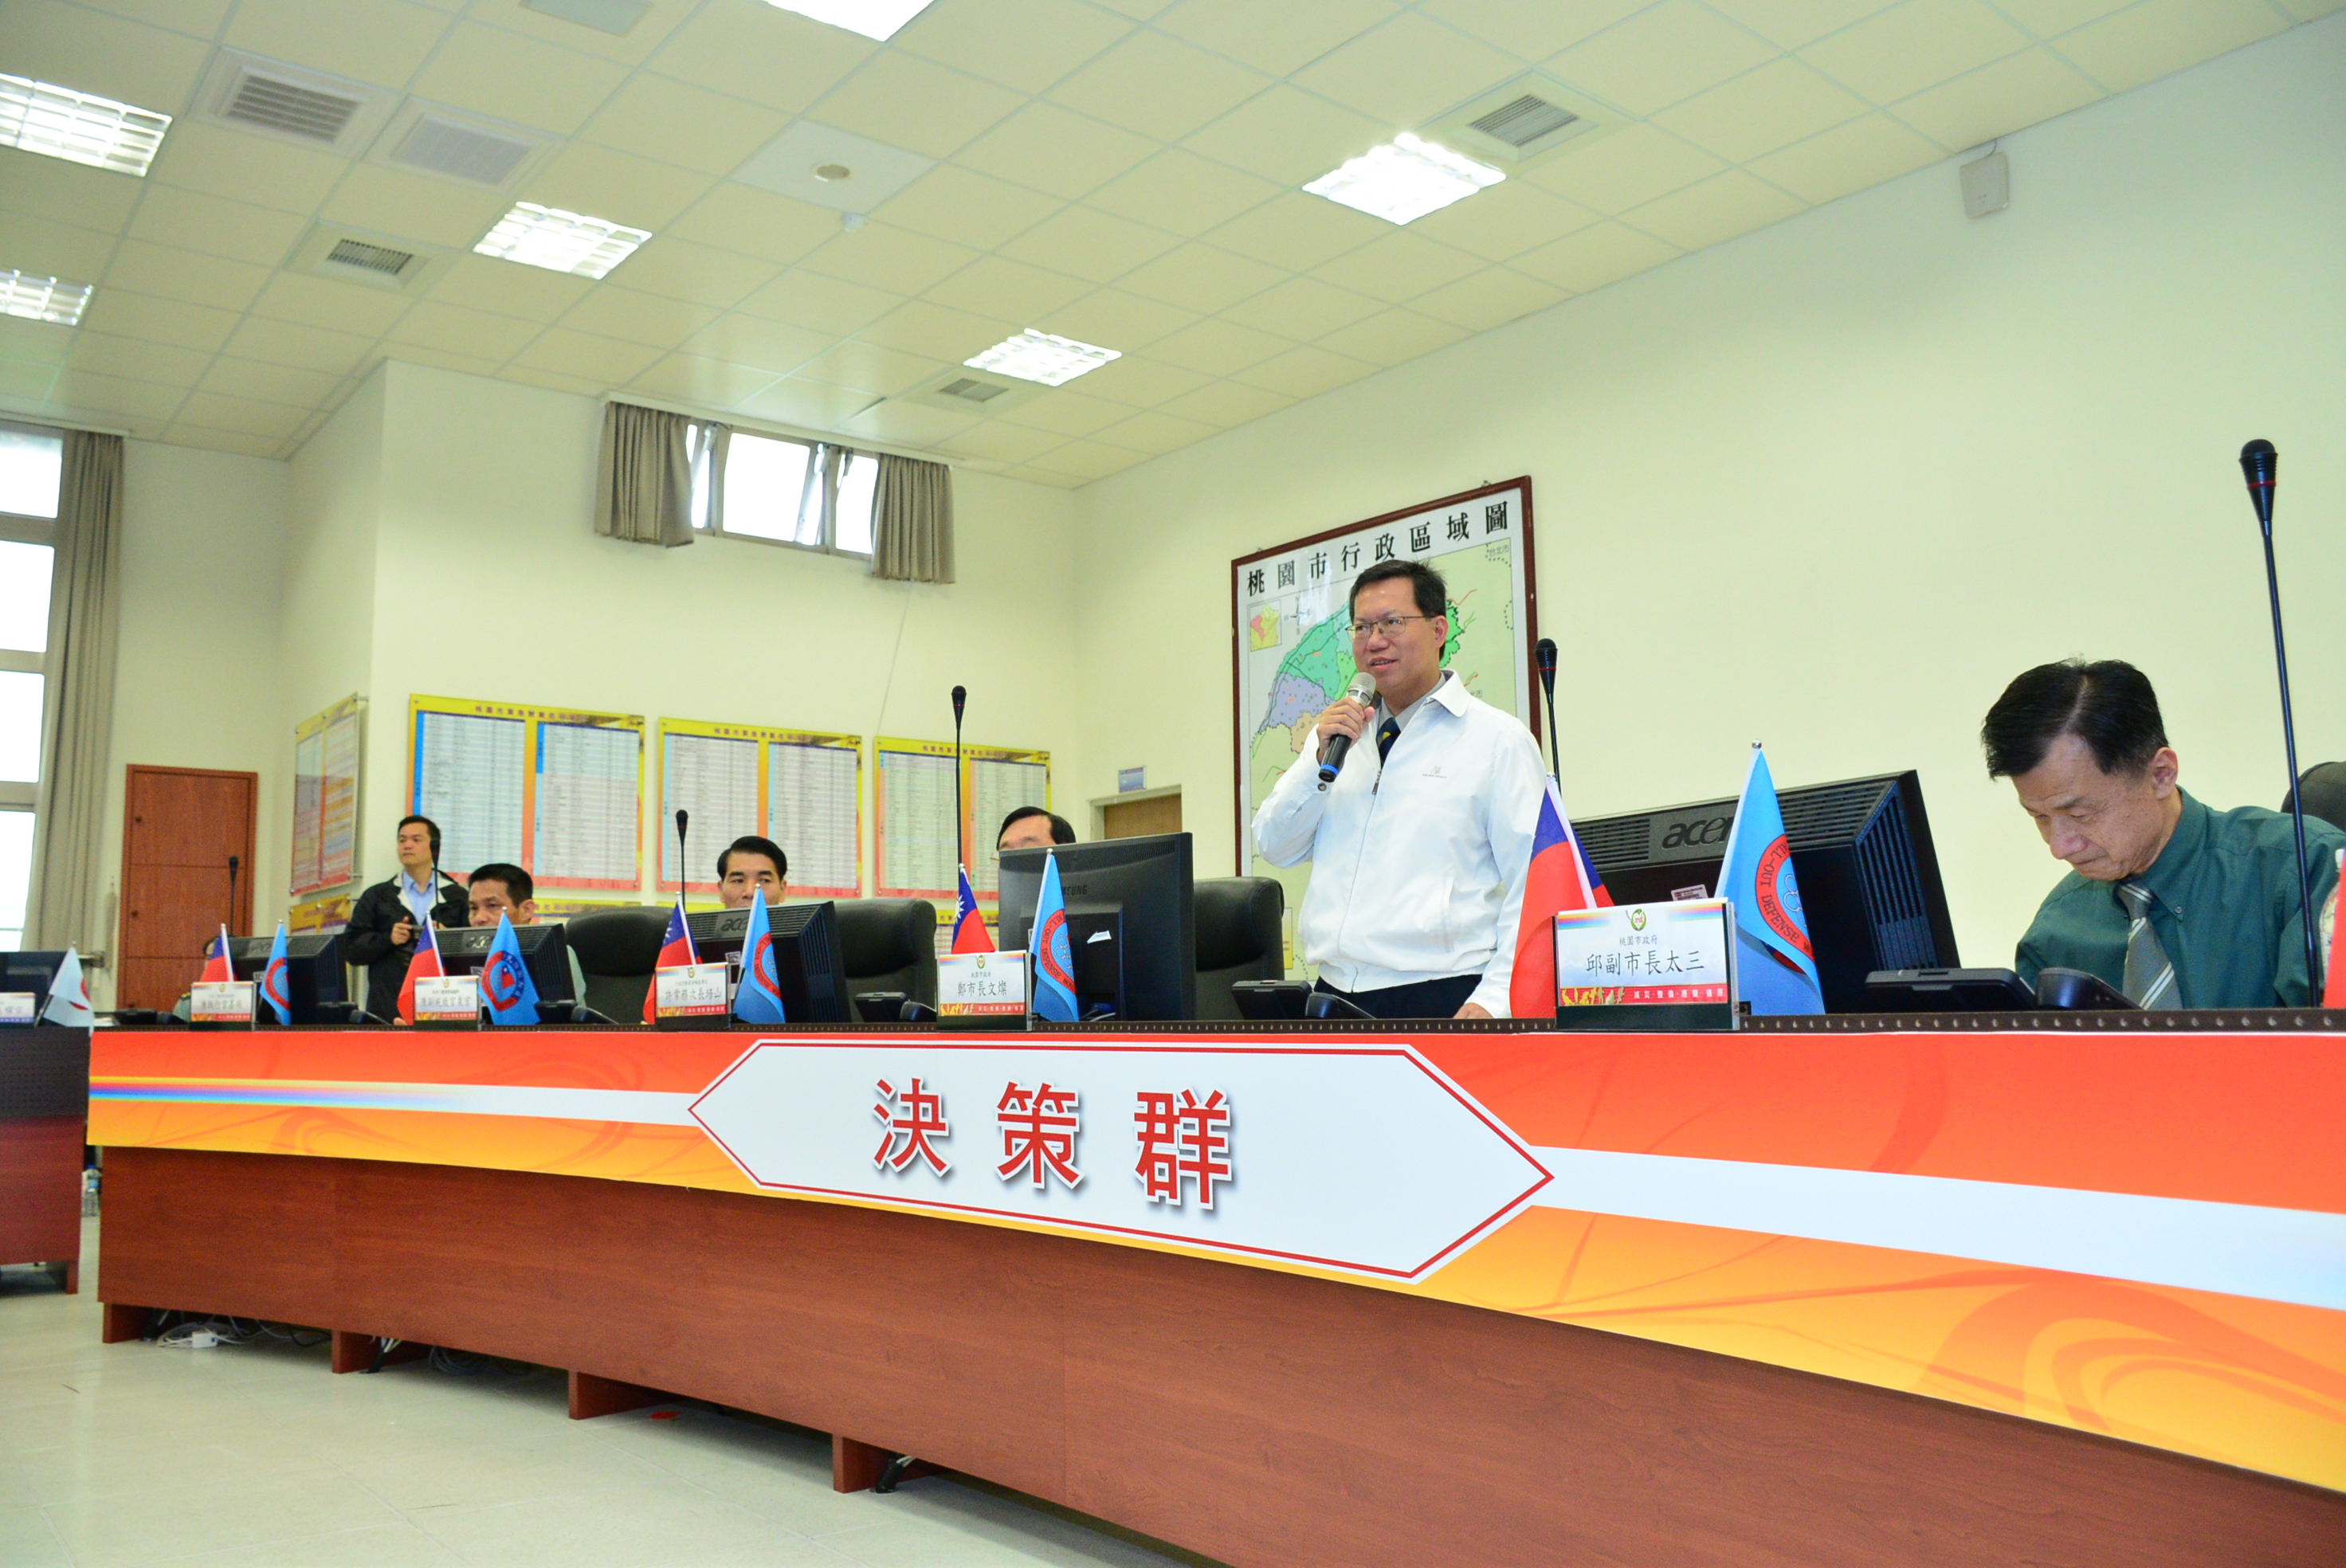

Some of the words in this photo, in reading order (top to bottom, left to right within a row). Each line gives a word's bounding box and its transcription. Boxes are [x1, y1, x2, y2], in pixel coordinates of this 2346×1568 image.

[1247, 500, 1508, 598] 桃園市行政區域圖
[1760, 894, 1800, 943] DEFENSE
[1618, 935, 1658, 947] 桃園市政府
[1586, 950, 1705, 977] 邱副市長太三
[956, 980, 1007, 997] 鄭市長文燦
[873, 1076, 1230, 1207] 決策群
